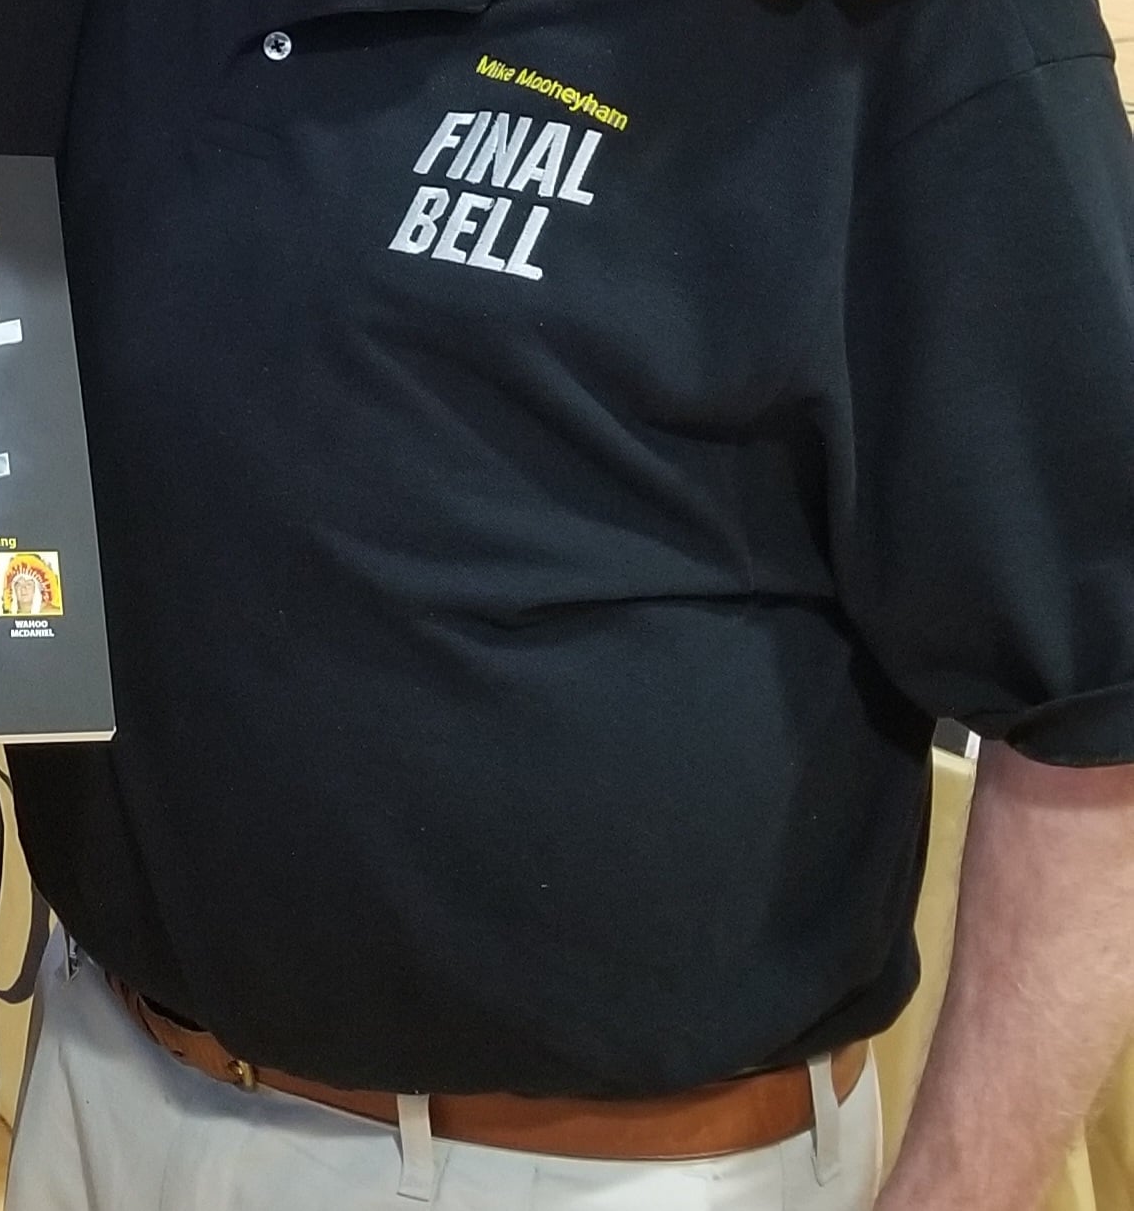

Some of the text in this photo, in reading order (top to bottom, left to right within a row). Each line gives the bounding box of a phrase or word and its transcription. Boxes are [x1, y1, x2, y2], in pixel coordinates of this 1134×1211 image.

[476, 55, 628, 131] Mike Mooneyham
[413, 111, 603, 205] FINAL
[388, 186, 550, 280] BELL
[11, 628, 55, 637] MCDANIEL
[15, 620, 48, 628] WAHOO
